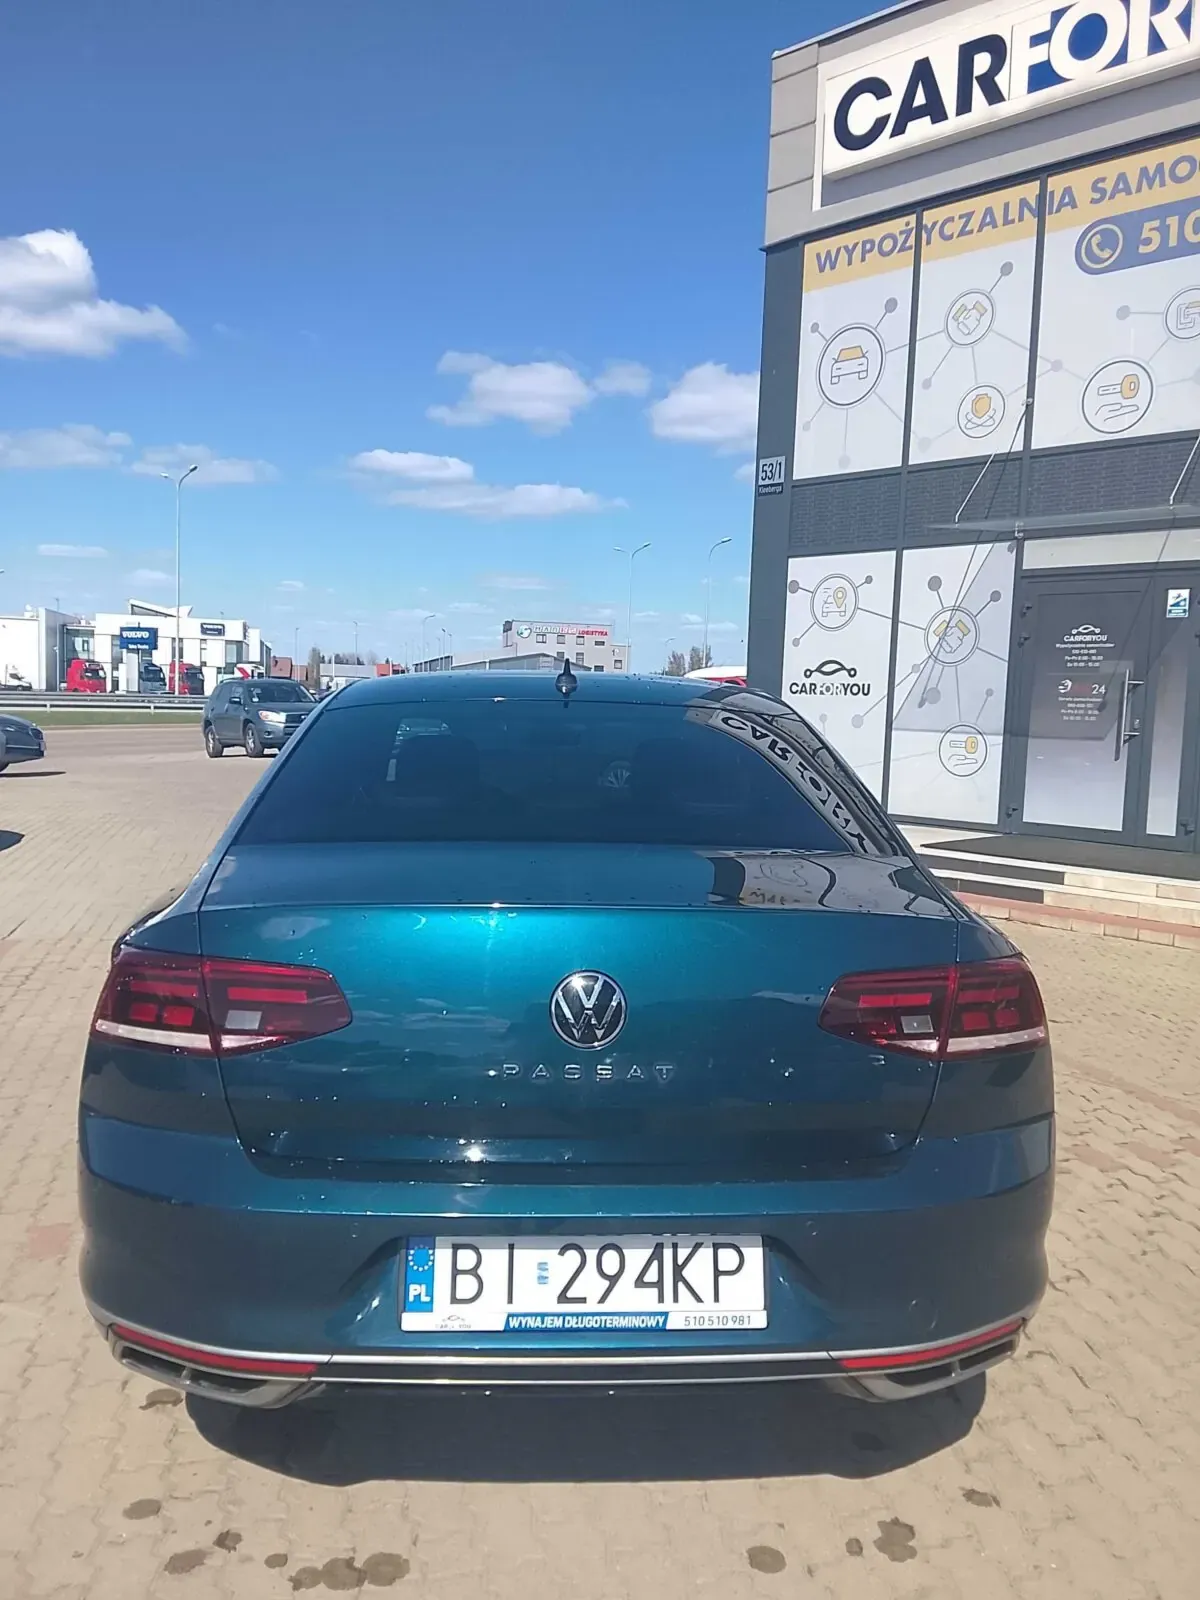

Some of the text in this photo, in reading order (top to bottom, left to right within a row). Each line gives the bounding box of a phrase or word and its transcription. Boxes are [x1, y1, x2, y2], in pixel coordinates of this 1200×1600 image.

[816, 154, 1200, 273] WYPOŻYCZALNIA SAMO
[761, 460, 782, 481] 53/1
[1091, 684, 1106, 695] 24
[502, 1064, 674, 1081] PASSAT
[556, 1242, 745, 1304] 294KP
[408, 1284, 431, 1302] PL
[508, 1315, 665, 1329] WYNAJEM DŁUGOTERMINOWY
[684, 1314, 751, 1327] 510 510 981
